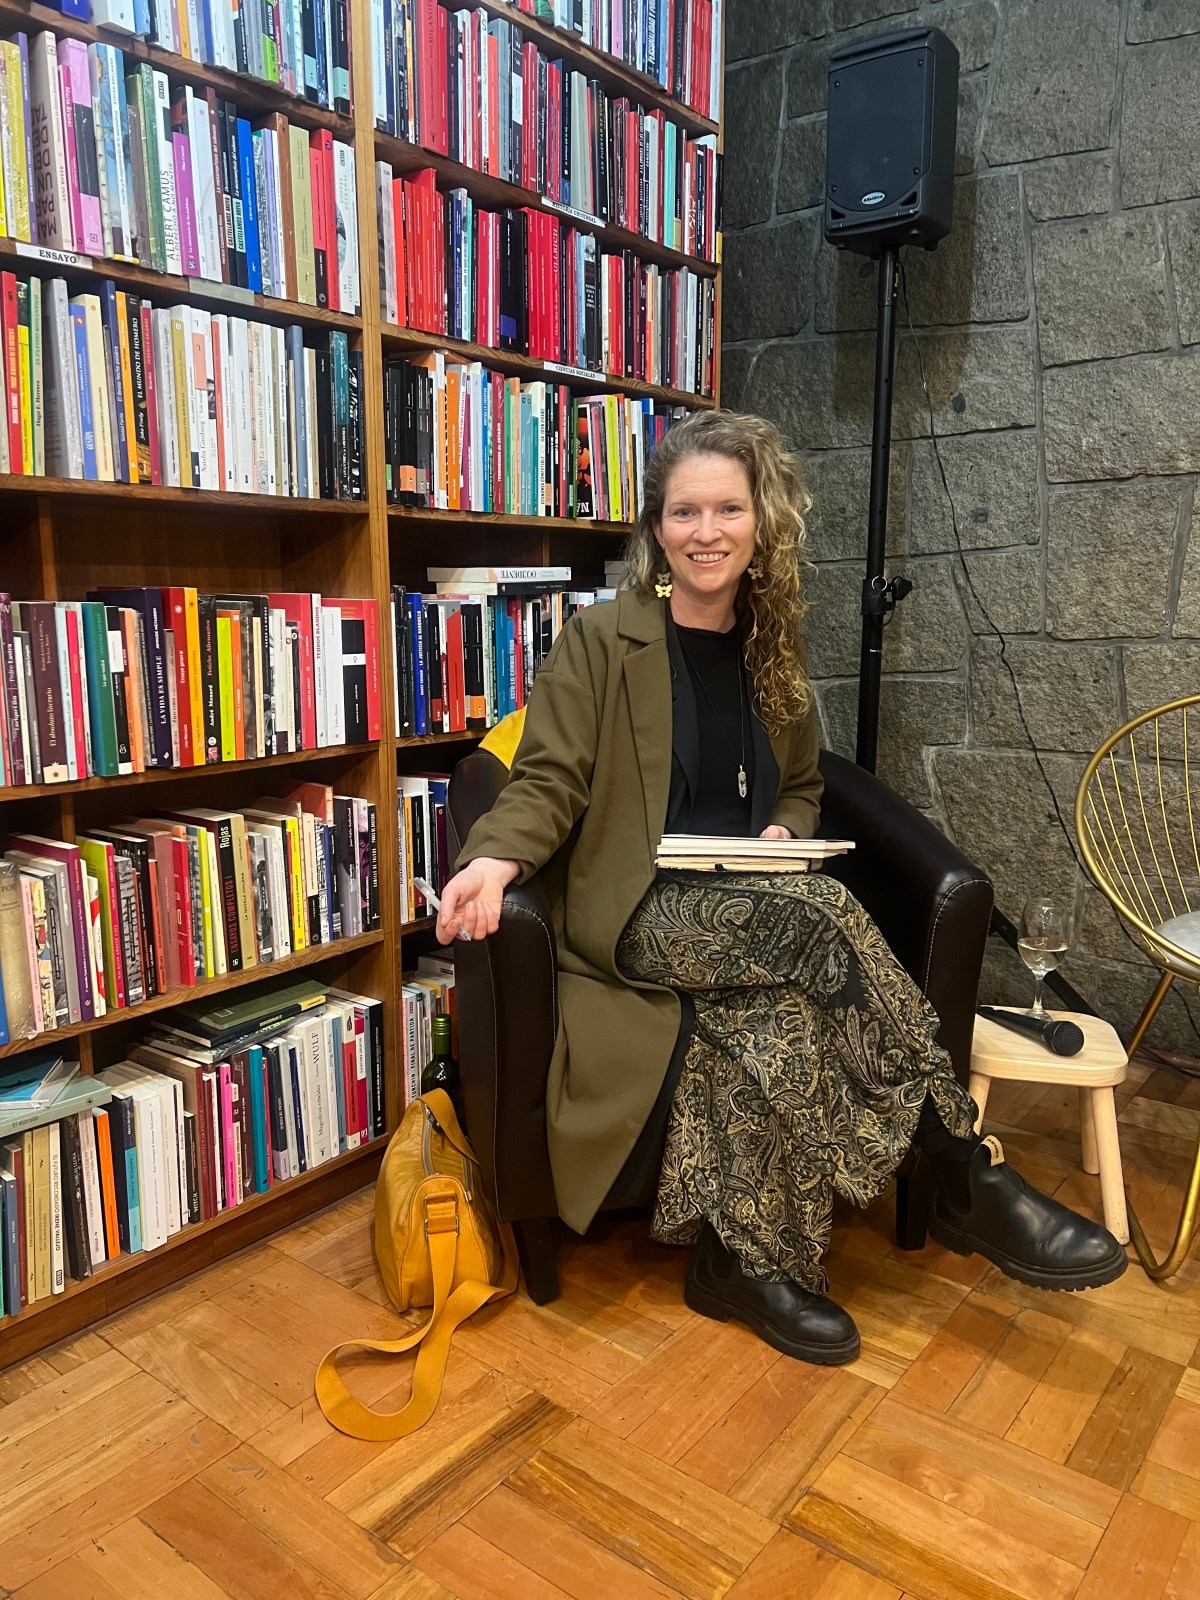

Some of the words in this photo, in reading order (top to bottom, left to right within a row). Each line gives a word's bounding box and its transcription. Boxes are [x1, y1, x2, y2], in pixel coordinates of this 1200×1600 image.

[160, 170, 172, 213] CAMUS
[162, 215, 176, 260] ALBERT
[225, 213, 234, 246] CASTELLANOS
[236, 218, 245, 250] CASTELLANOS
[39, 251, 77, 264] ENSAYO
[134, 350, 140, 360] DE
[555, 365, 576, 374] CIENCIAS
[137, 390, 143, 398] EL
[6, 643, 14, 664] Lastra
[156, 655, 164, 683] SIMPLE
[157, 684, 165, 694] ES
[510, 677, 515, 685] LO
[158, 695, 166, 713] VIDA
[47, 713, 56, 739] absoluto
[160, 714, 167, 724] LA
[49, 739, 57, 747] El
[219, 826, 231, 848] Rojas
[225, 880, 237, 921] COMPLETOS
[228, 922, 239, 953] ENSAYOS
[311, 1032, 320, 1065] WULF
